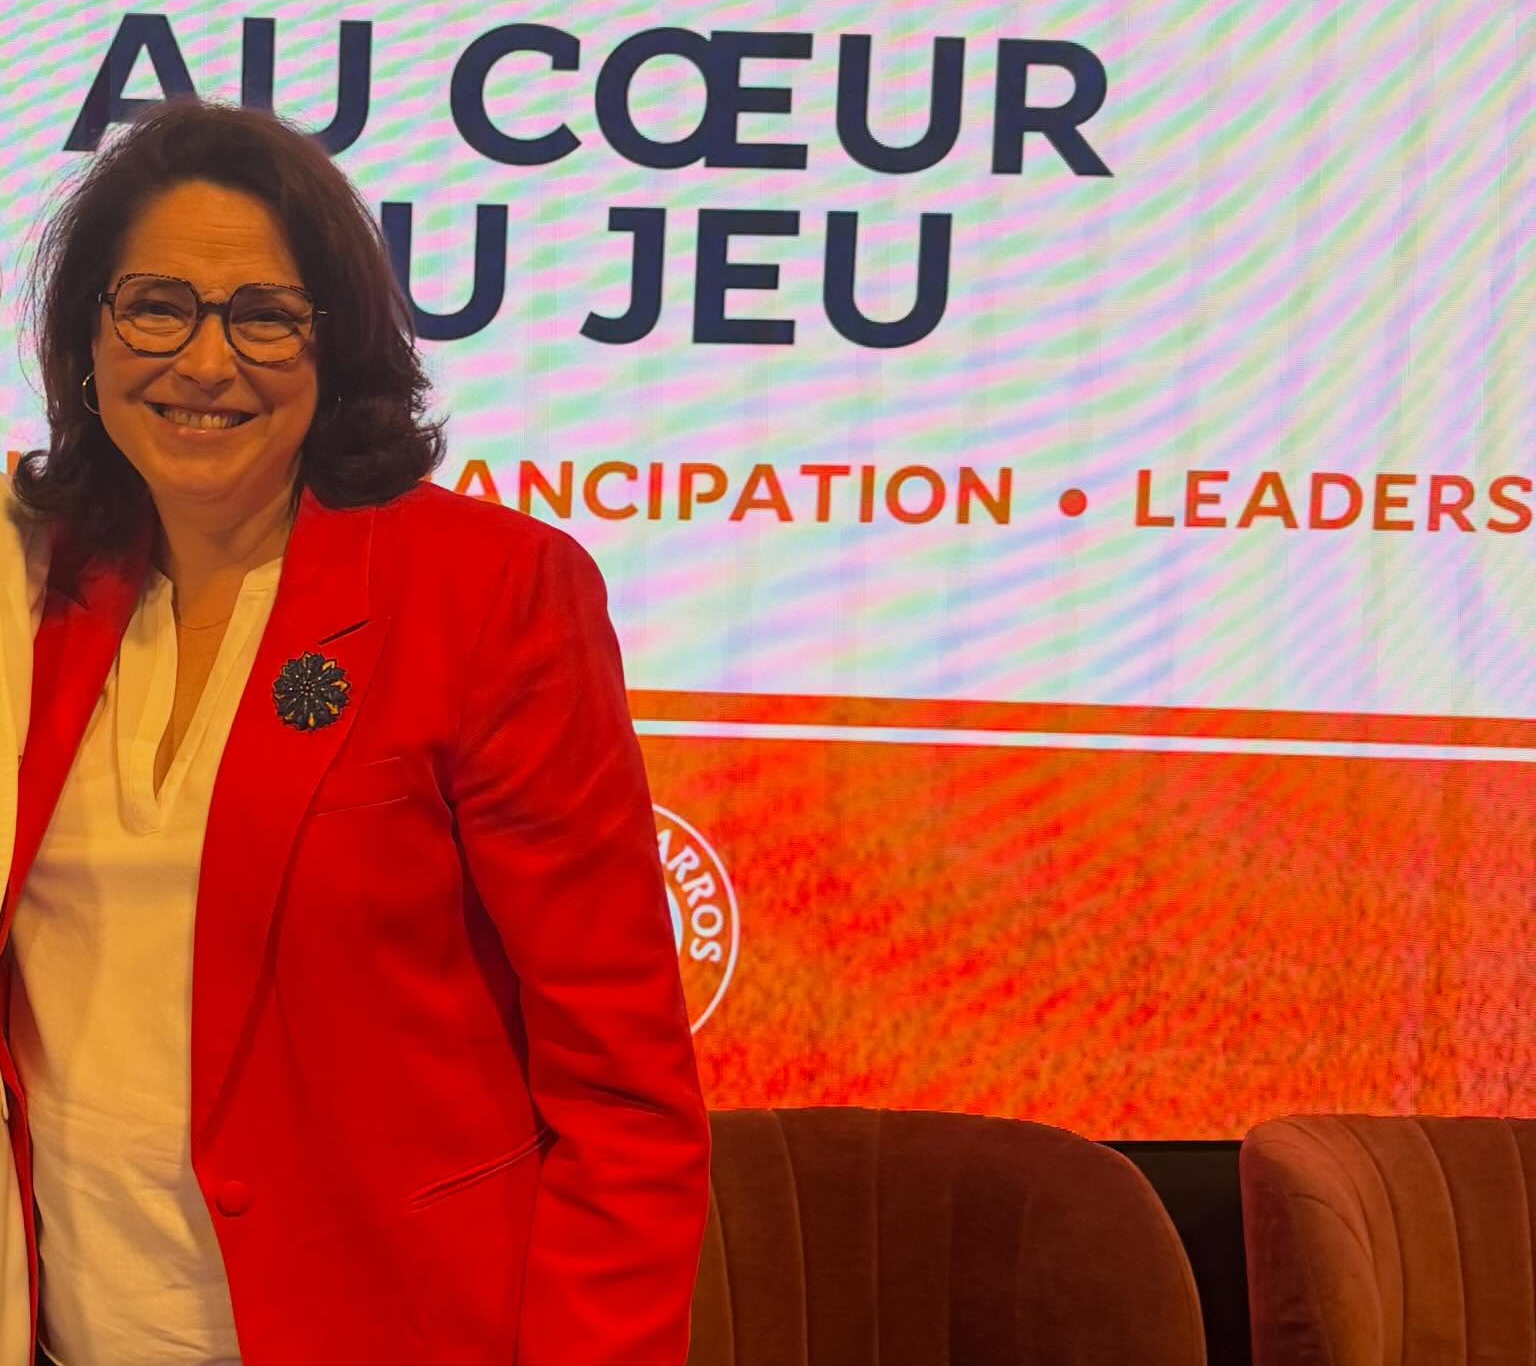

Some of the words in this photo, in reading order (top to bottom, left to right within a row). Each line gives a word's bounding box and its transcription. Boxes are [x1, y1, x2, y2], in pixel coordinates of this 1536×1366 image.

[61, 12, 373, 159] AU
[449, 23, 1114, 177] CŒUR
[378, 201, 509, 342] U
[579, 206, 953, 349] JEU
[419, 459, 1013, 525] ANCIPATION
[656, 828, 724, 963] ARROS
